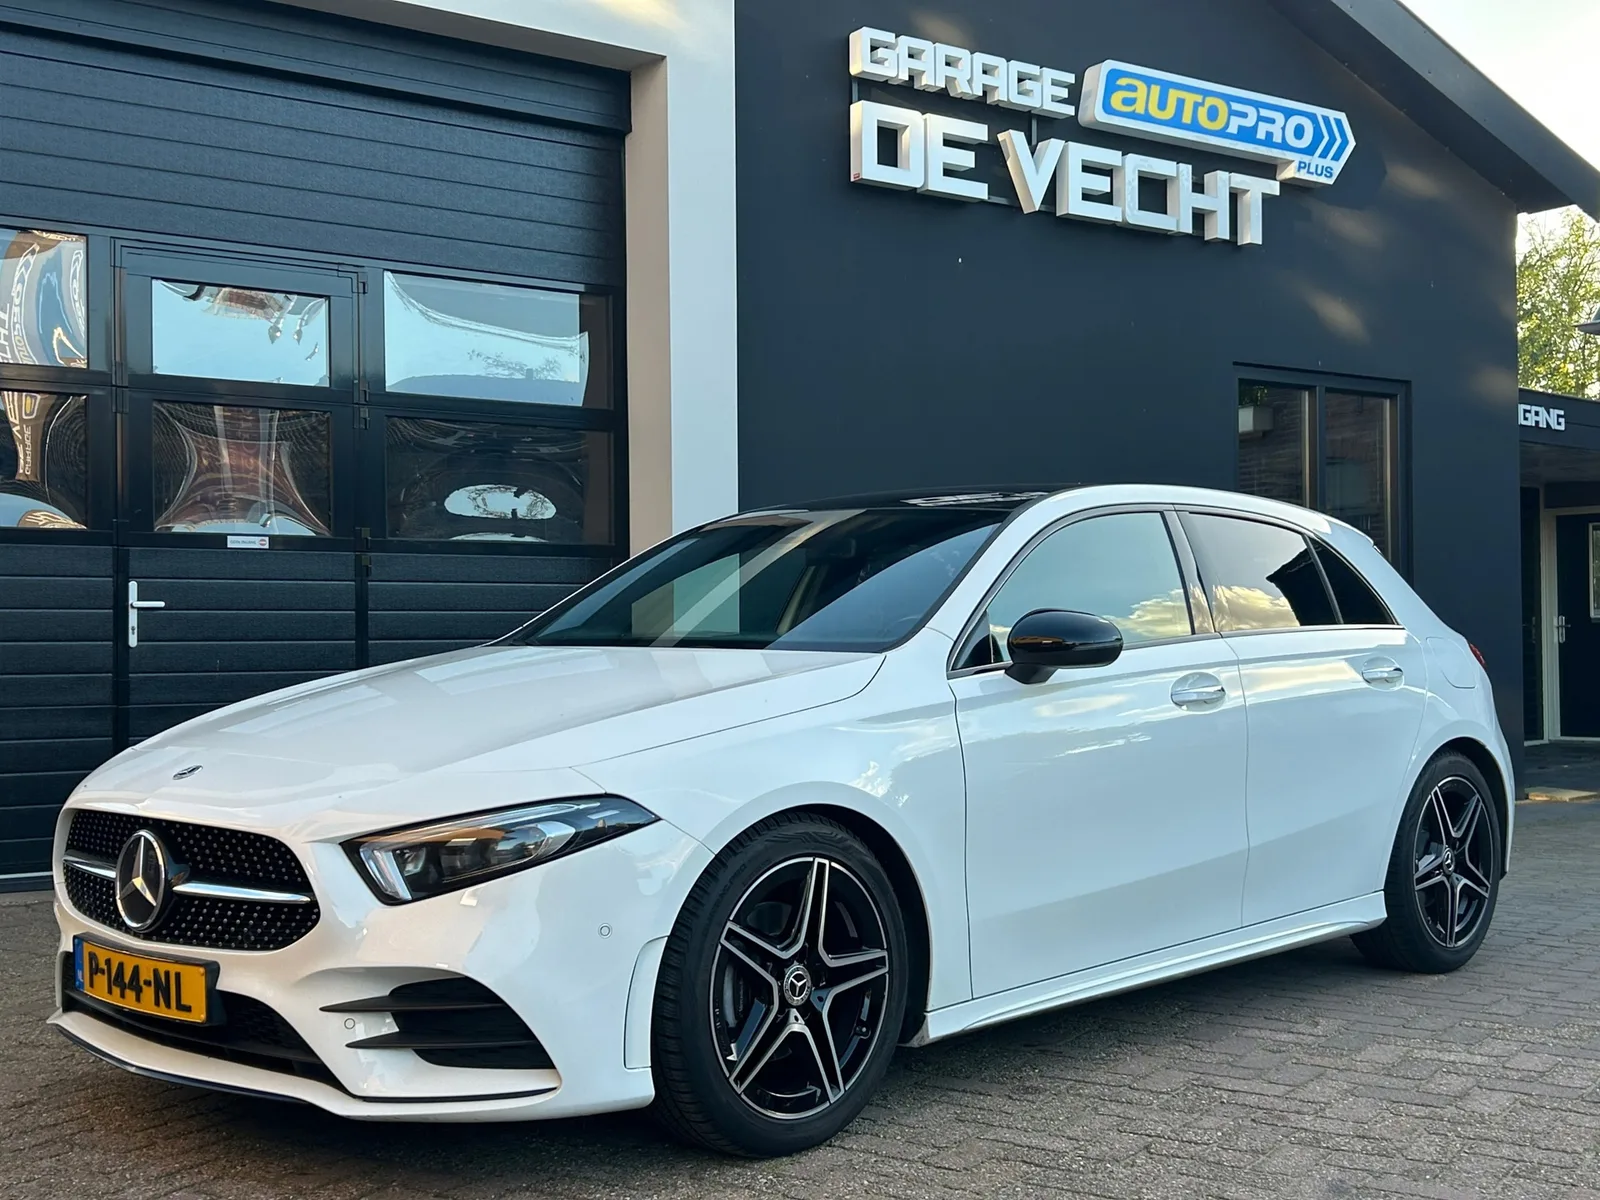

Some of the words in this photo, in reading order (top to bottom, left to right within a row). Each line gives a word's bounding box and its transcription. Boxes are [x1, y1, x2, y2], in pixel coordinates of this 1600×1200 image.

[850, 27, 1075, 118] GARAGE
[850, 100, 988, 201] DE
[997, 129, 1280, 245] VECHT
[1296, 160, 1334, 179] PLUS
[1518, 403, 1566, 431] GANG
[88, 951, 192, 1013] P-144-NL
